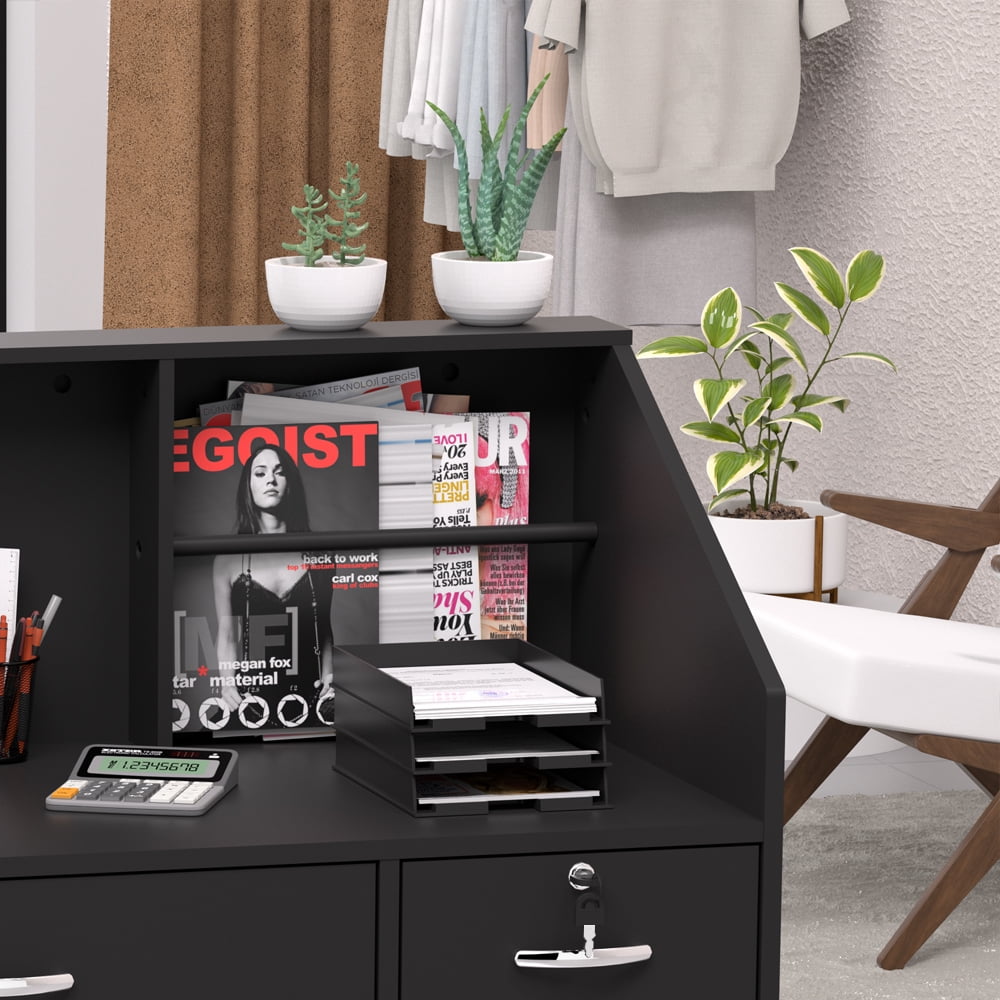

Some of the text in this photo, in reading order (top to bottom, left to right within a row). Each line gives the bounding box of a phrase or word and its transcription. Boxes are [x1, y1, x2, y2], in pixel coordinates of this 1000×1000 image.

[327, 378, 379, 395] TEKNOLOJİ
[381, 369, 419, 386] DERGİSİ
[443, 462, 469, 472] Every
[443, 471, 469, 481] Every
[447, 514, 471, 526] Tells
[303, 552, 379, 564] back to work
[450, 560, 473, 570] BEST
[331, 572, 379, 584] carl cox
[437, 568, 473, 579] PLAY UP
[442, 577, 474, 588] TRICKS
[218, 656, 292, 672] megan fox
[209, 671, 279, 687] material
